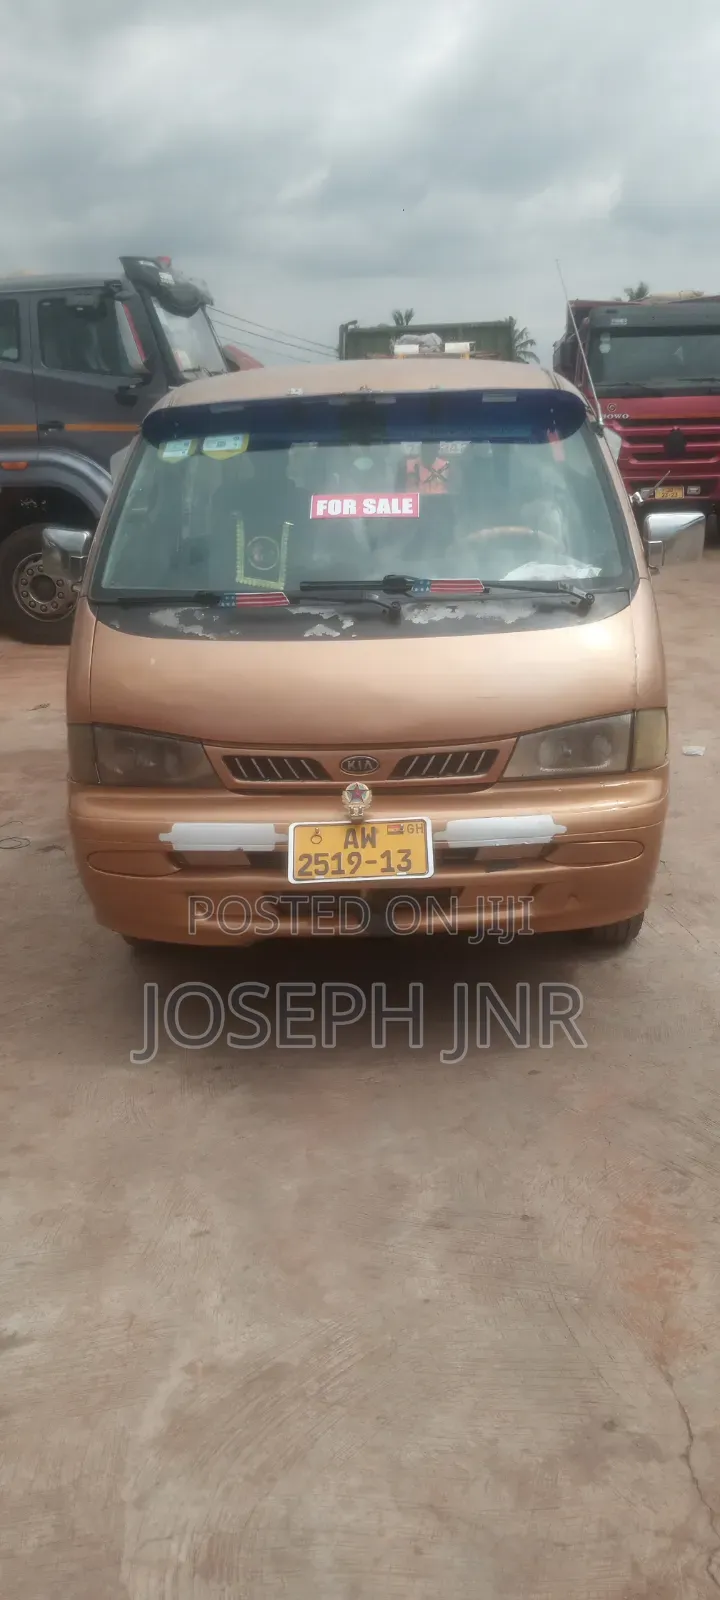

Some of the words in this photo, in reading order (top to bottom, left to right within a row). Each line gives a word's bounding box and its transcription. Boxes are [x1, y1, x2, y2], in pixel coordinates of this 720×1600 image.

[316, 499, 357, 516] FOR
[362, 498, 414, 515] SALE
[347, 760, 373, 770] KIA
[344, 826, 377, 849] AW
[406, 823, 424, 834] GH
[297, 849, 412, 876] 2519-13
